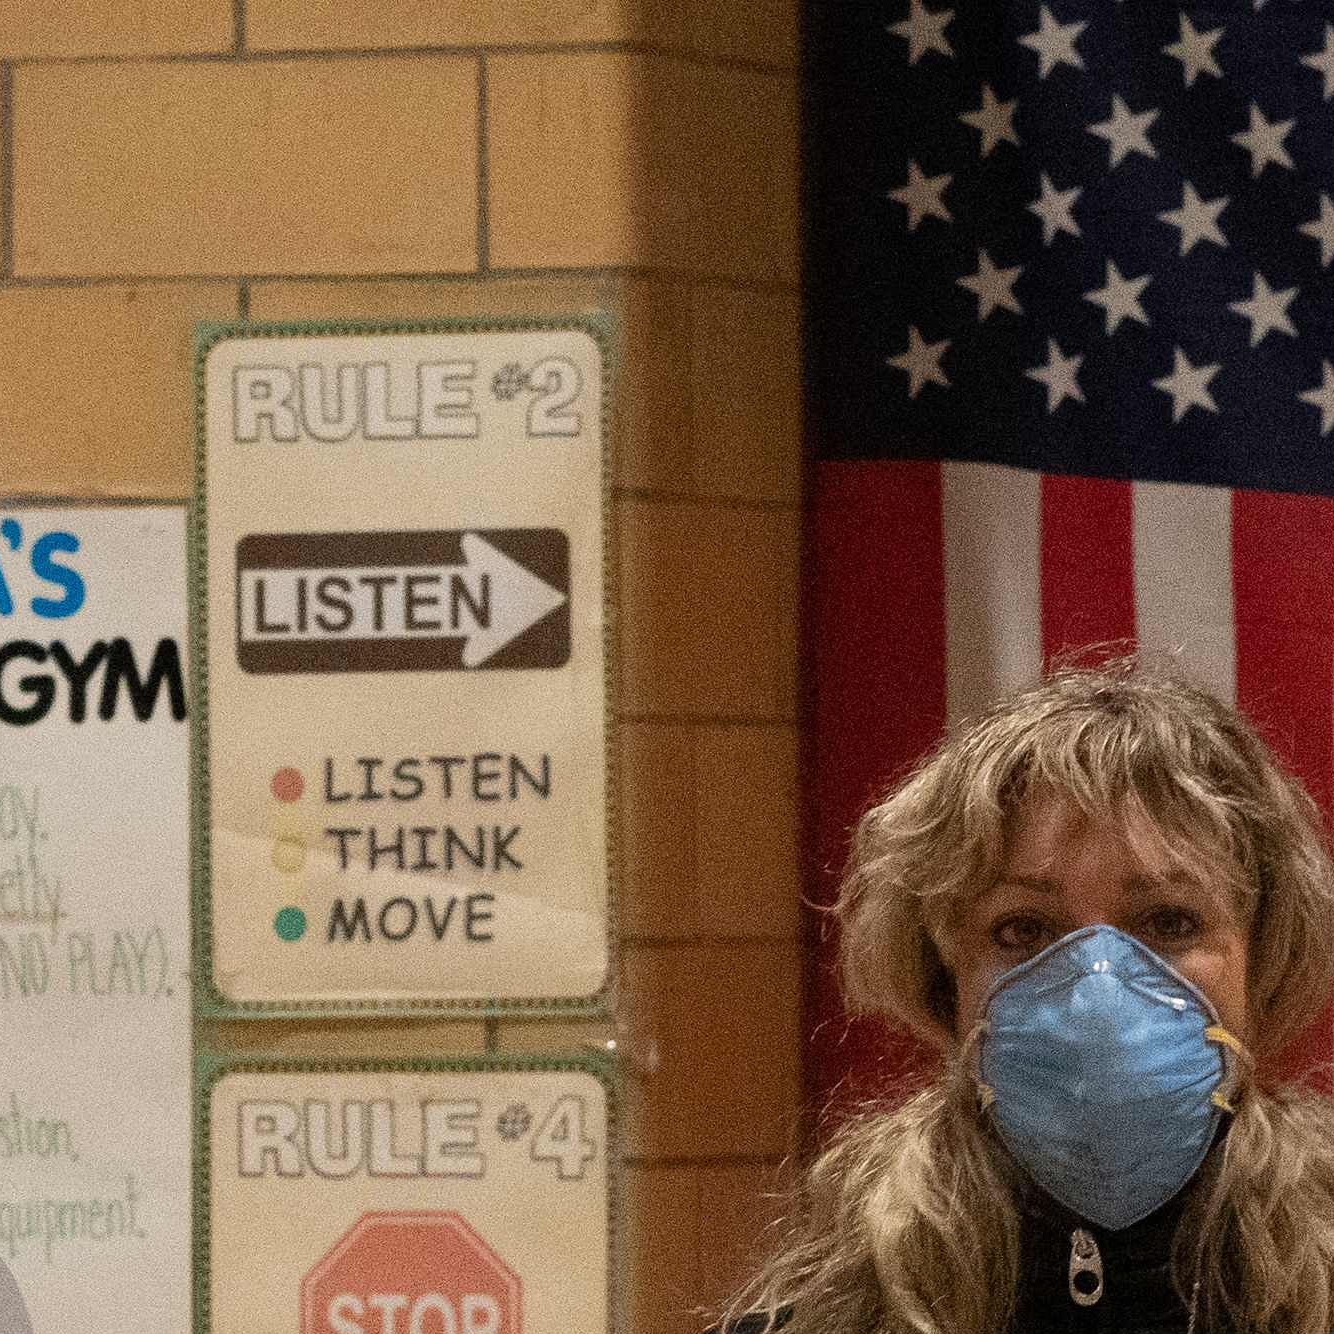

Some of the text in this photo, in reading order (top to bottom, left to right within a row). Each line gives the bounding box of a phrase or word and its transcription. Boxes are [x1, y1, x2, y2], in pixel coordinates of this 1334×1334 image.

[233, 354, 584, 443] RULE #2
[253, 572, 493, 636] LISTEN
[323, 753, 552, 802] LISTEN
[325, 825, 524, 873] THINK
[326, 895, 495, 943] MOVE
[237, 1095, 597, 1181] RULE #4
